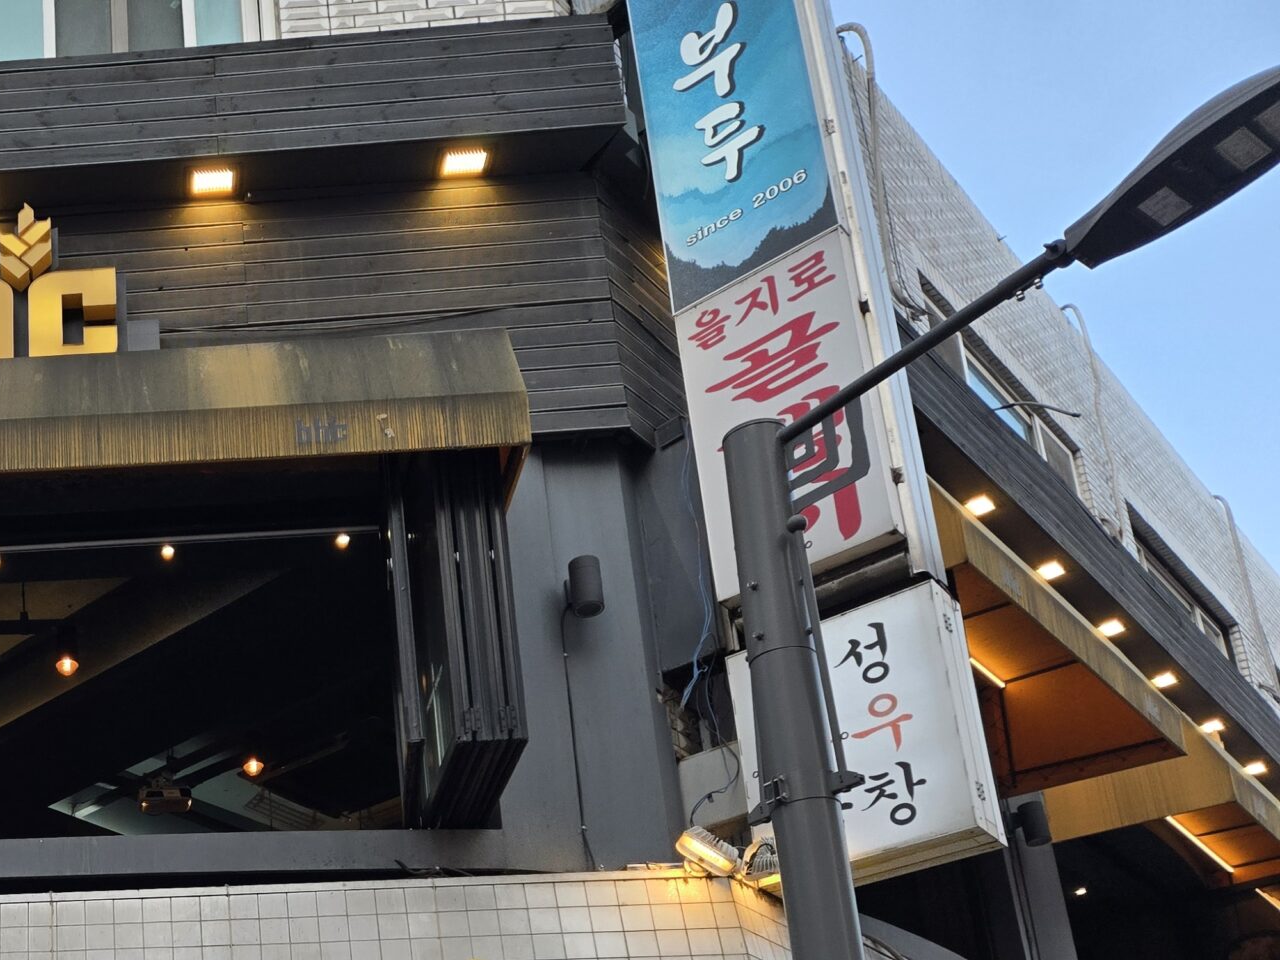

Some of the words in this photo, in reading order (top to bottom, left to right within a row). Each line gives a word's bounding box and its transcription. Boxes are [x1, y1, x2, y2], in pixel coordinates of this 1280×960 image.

[672, 0, 765, 182] 부두
[686, 207, 743, 247] since
[752, 168, 808, 209] 2006
[687, 250, 837, 350] 을지로
[841, 761, 927, 826] 창
